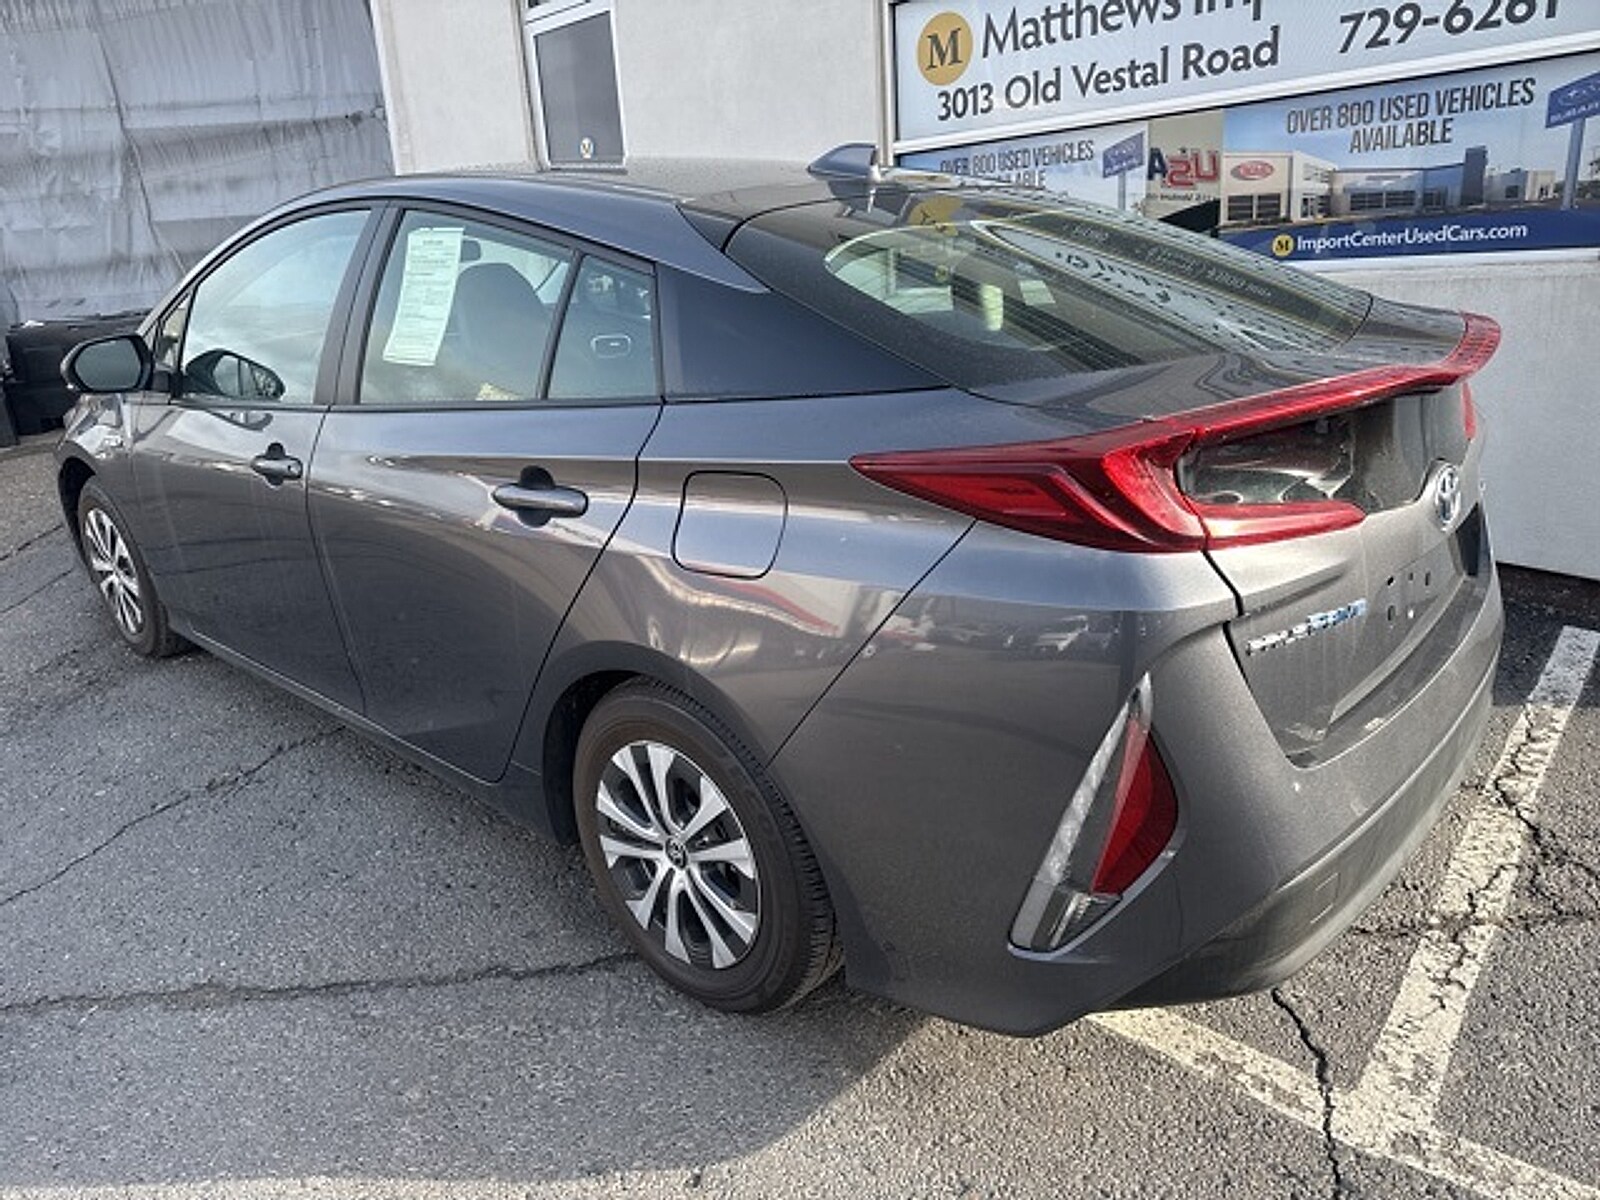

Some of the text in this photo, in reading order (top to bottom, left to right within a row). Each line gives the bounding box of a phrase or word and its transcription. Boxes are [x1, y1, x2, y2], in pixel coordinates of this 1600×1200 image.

[926, 28, 963, 71] M
[981, 0, 1182, 59] Matthews
[937, 83, 993, 121] 3013
[1005, 66, 1062, 108] Old
[1072, 45, 1168, 97] Vestal
[1182, 25, 1280, 80] Road
[1287, 105, 1332, 134] OVER
[1336, 100, 1375, 128] 800
[1380, 92, 1430, 121] USED
[1435, 77, 1537, 115] VEHICLES
[1032, 140, 1094, 167] VEHICLES
[1349, 117, 1455, 153] AVAILABLE
[1297, 224, 1529, 254] ImportCenterUsedCars.com
